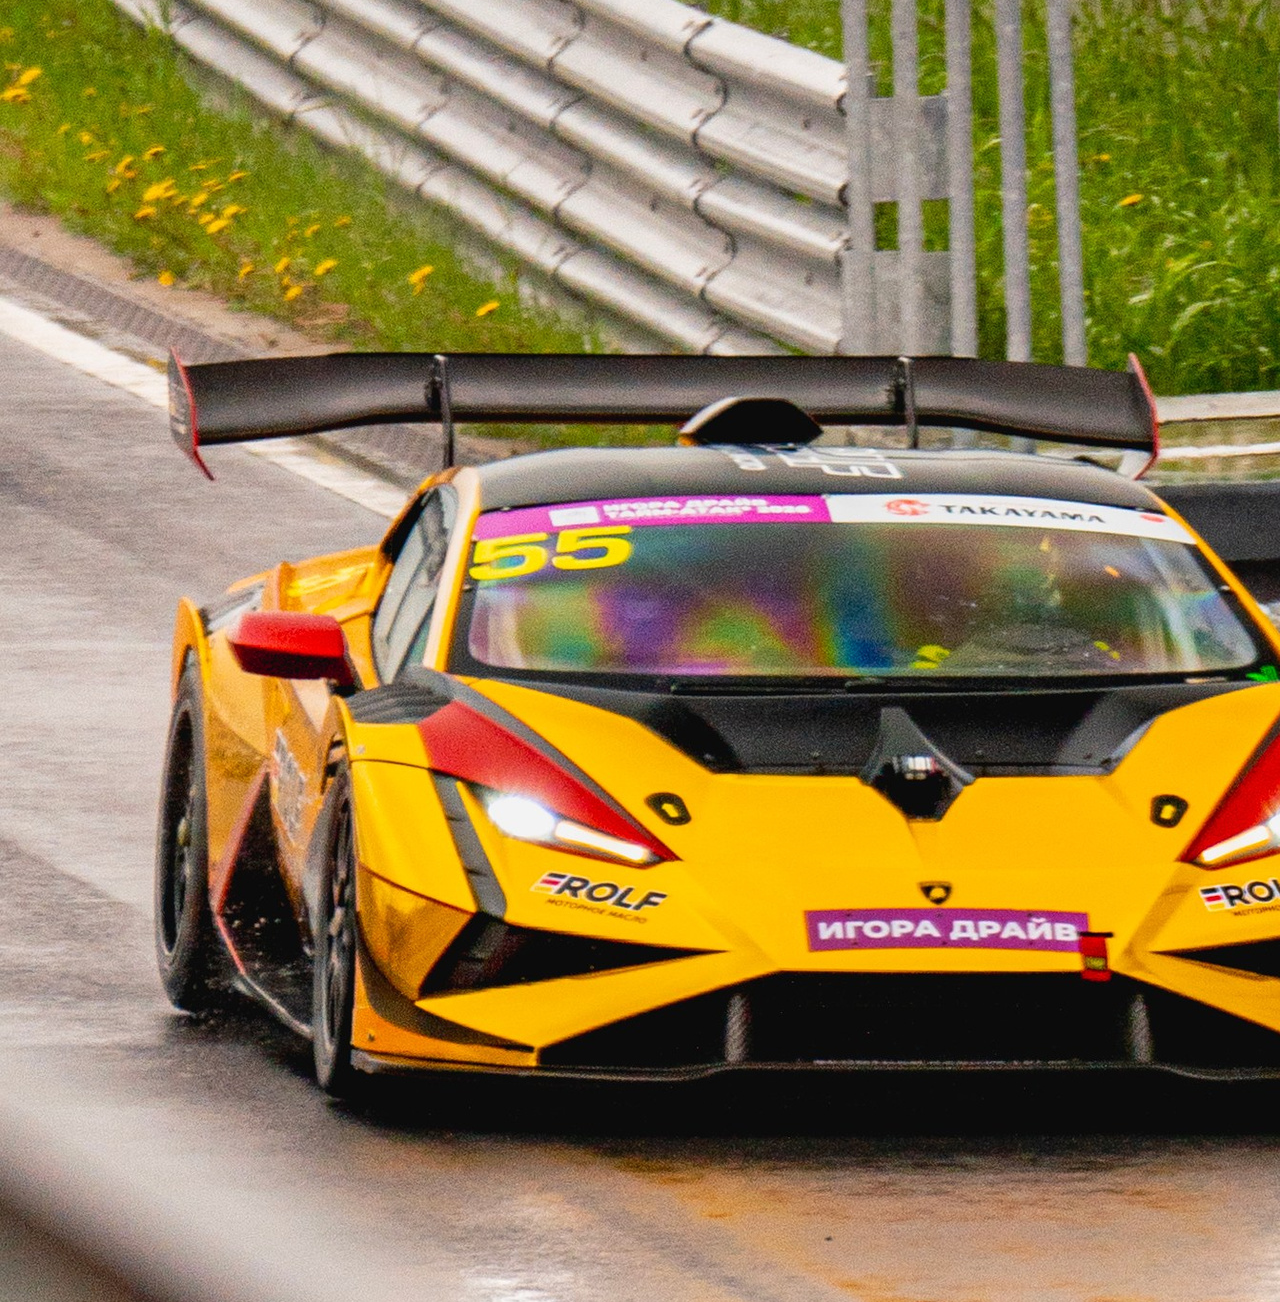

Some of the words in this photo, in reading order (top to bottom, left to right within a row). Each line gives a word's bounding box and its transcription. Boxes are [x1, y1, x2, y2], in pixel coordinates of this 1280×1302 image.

[939, 504, 1106, 523] TAKAYAMA
[469, 525, 632, 581] 55
[554, 875, 668, 911] ROLF
[818, 919, 941, 940] ИГОРА
[949, 917, 1080, 941] ДРАЙВ
